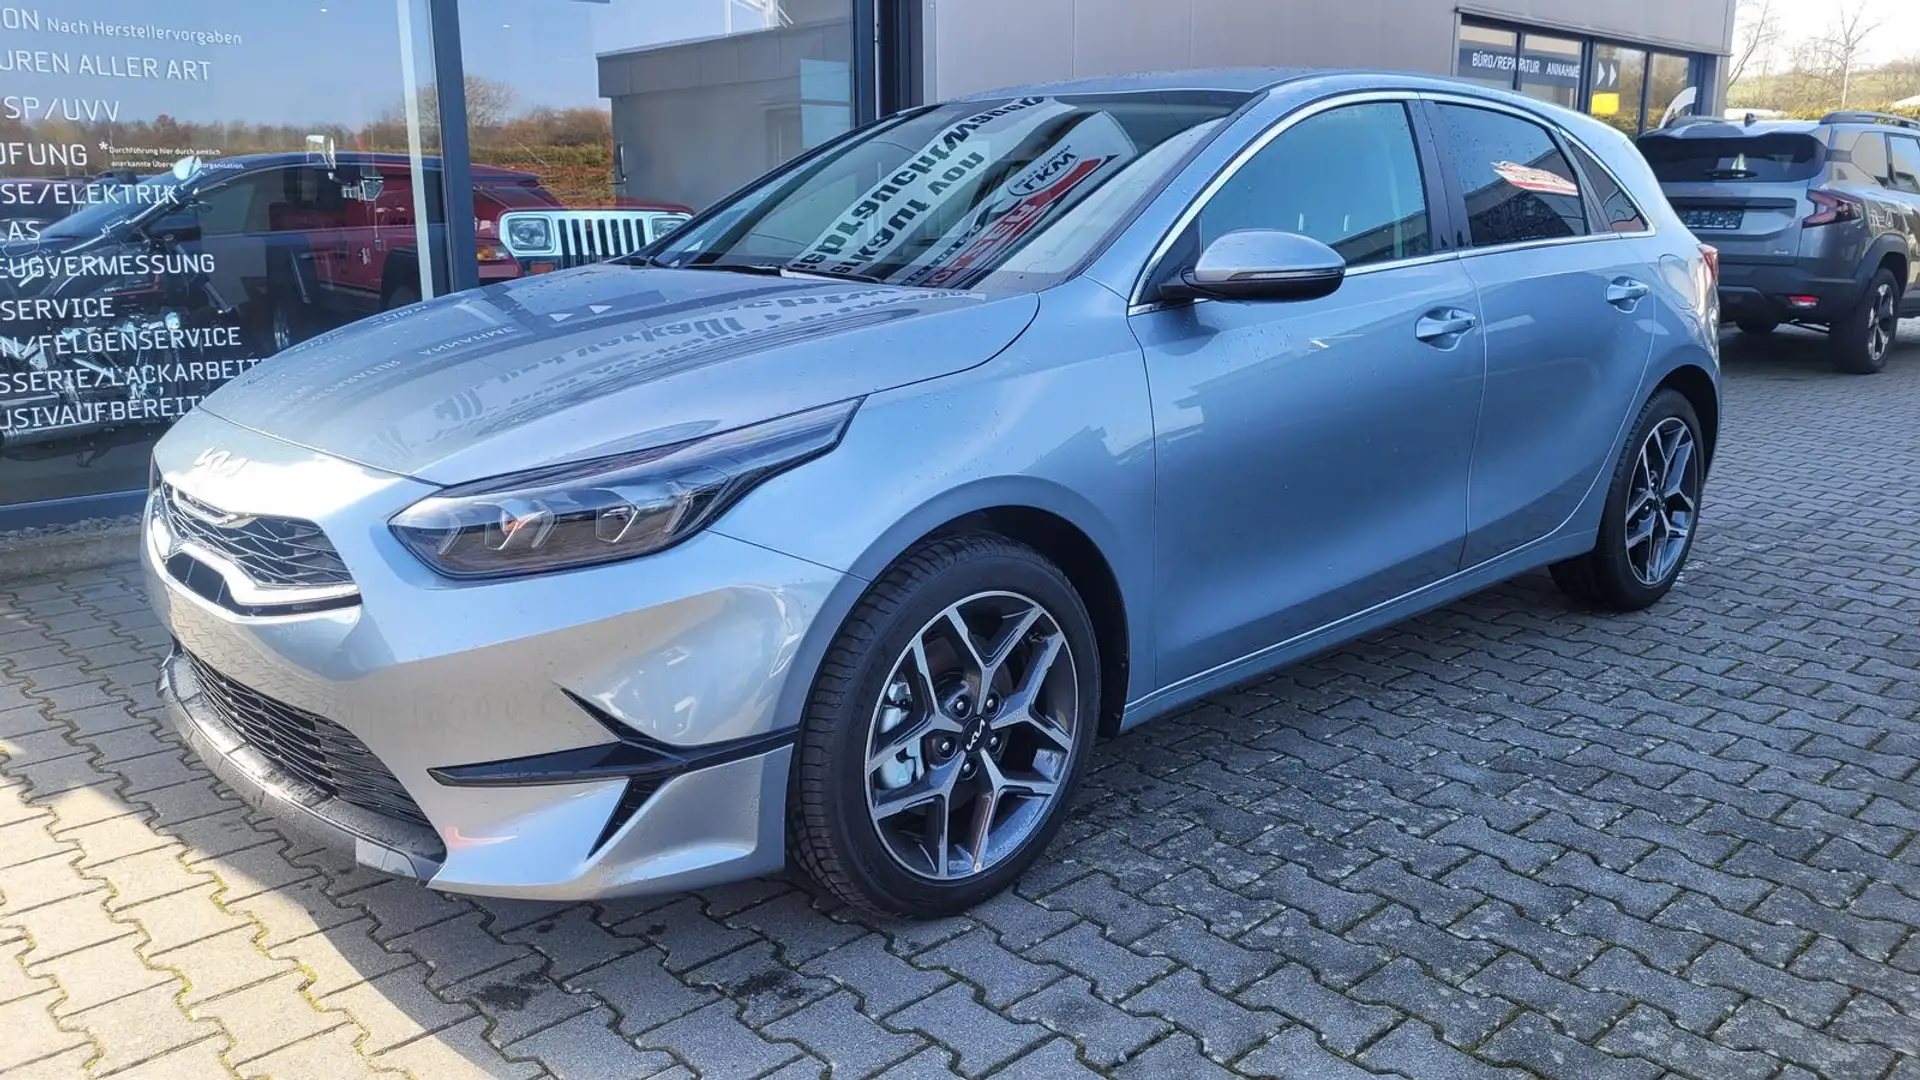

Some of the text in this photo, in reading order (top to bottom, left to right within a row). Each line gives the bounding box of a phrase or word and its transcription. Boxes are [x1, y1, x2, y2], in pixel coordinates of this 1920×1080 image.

[0, 7, 242, 46] ON Nach Herstellervorgaben
[79, 54, 158, 79] ALLER
[167, 59, 211, 82] ART
[1546, 61, 1580, 78] ANNAHME
[1, 297, 115, 321] SERVICE
[0, 358, 268, 394] SSERIE/LACKARBEIT
[0, 395, 206, 430] USIVAUFBEREIT
